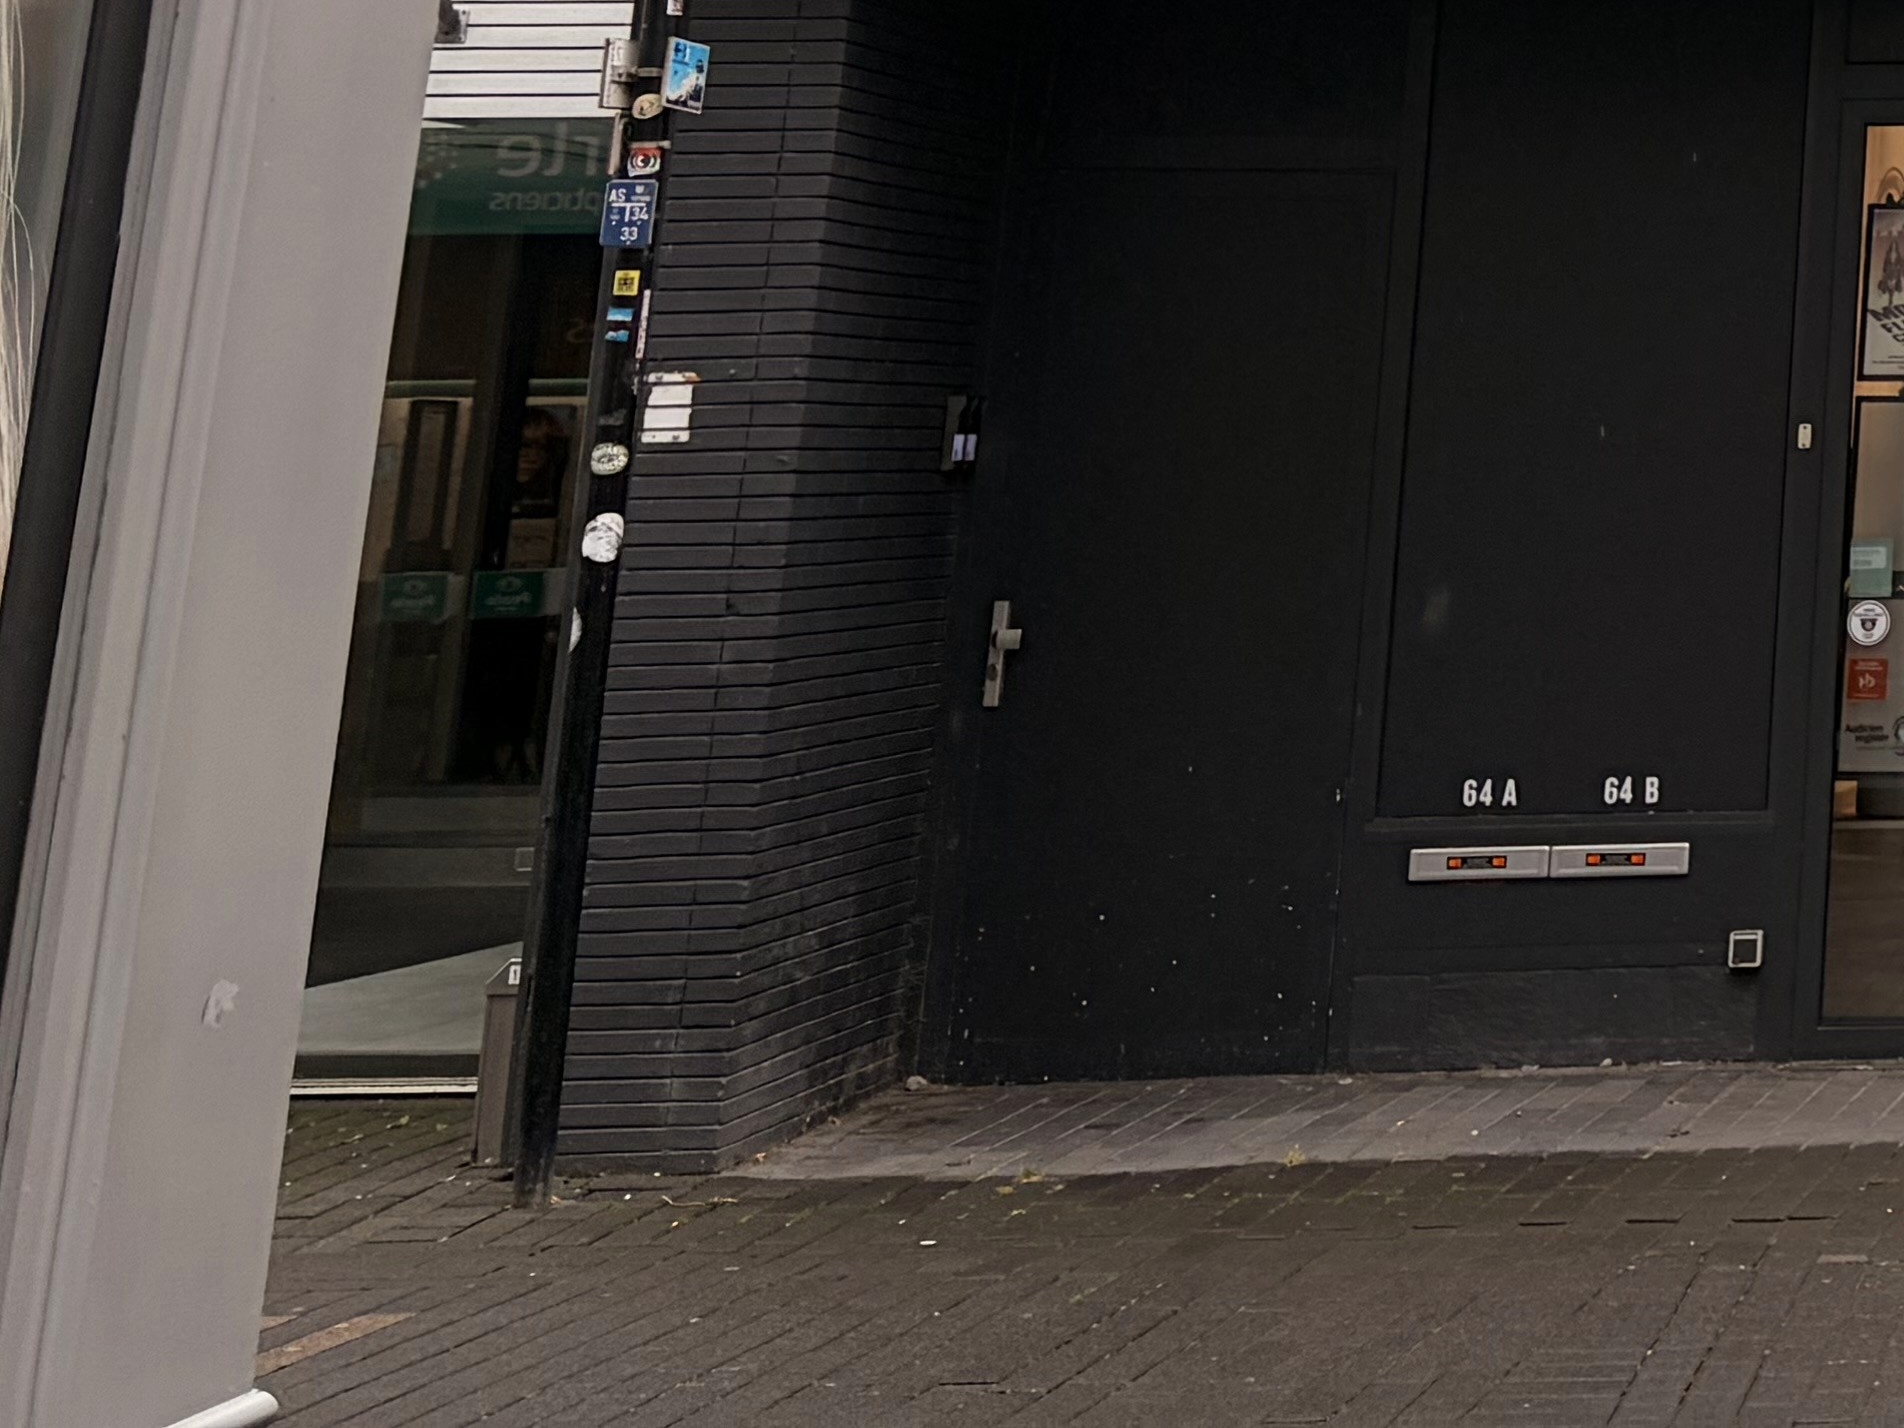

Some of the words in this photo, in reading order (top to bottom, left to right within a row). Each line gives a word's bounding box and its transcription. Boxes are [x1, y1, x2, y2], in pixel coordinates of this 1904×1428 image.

[608, 188, 627, 203] AS
[1462, 778, 1493, 808] 64
[1501, 777, 1518, 807] A
[1603, 776, 1634, 806] 64
[1644, 775, 1660, 804] B
